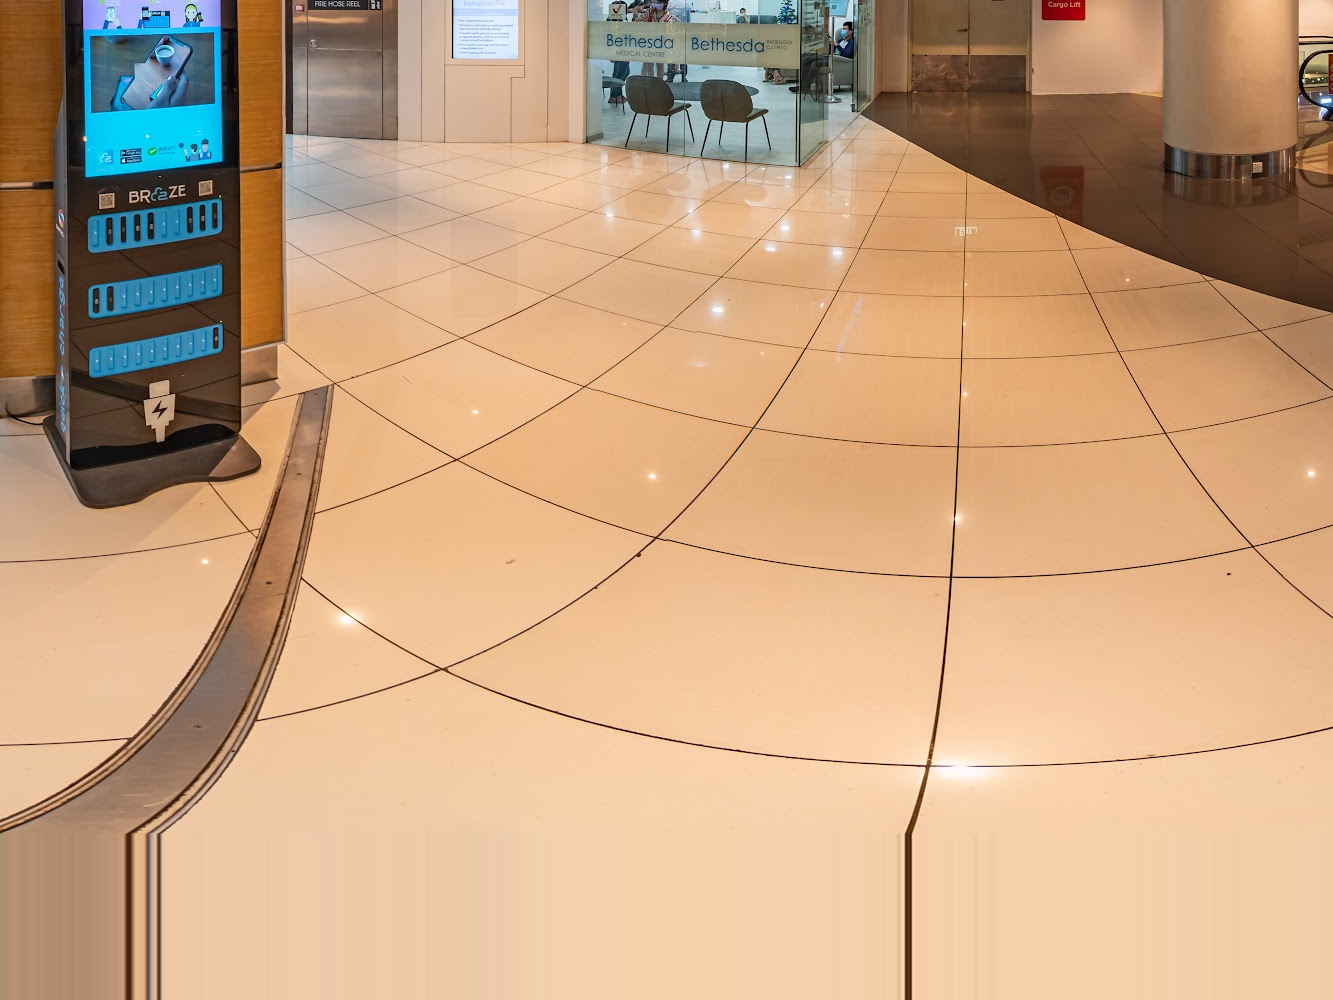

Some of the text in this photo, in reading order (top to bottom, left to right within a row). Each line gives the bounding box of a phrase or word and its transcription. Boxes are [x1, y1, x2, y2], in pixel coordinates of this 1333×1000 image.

[606, 34, 674, 49] Bethesda
[692, 37, 765, 53] Bethesda
[58, 276, 66, 356] charge
